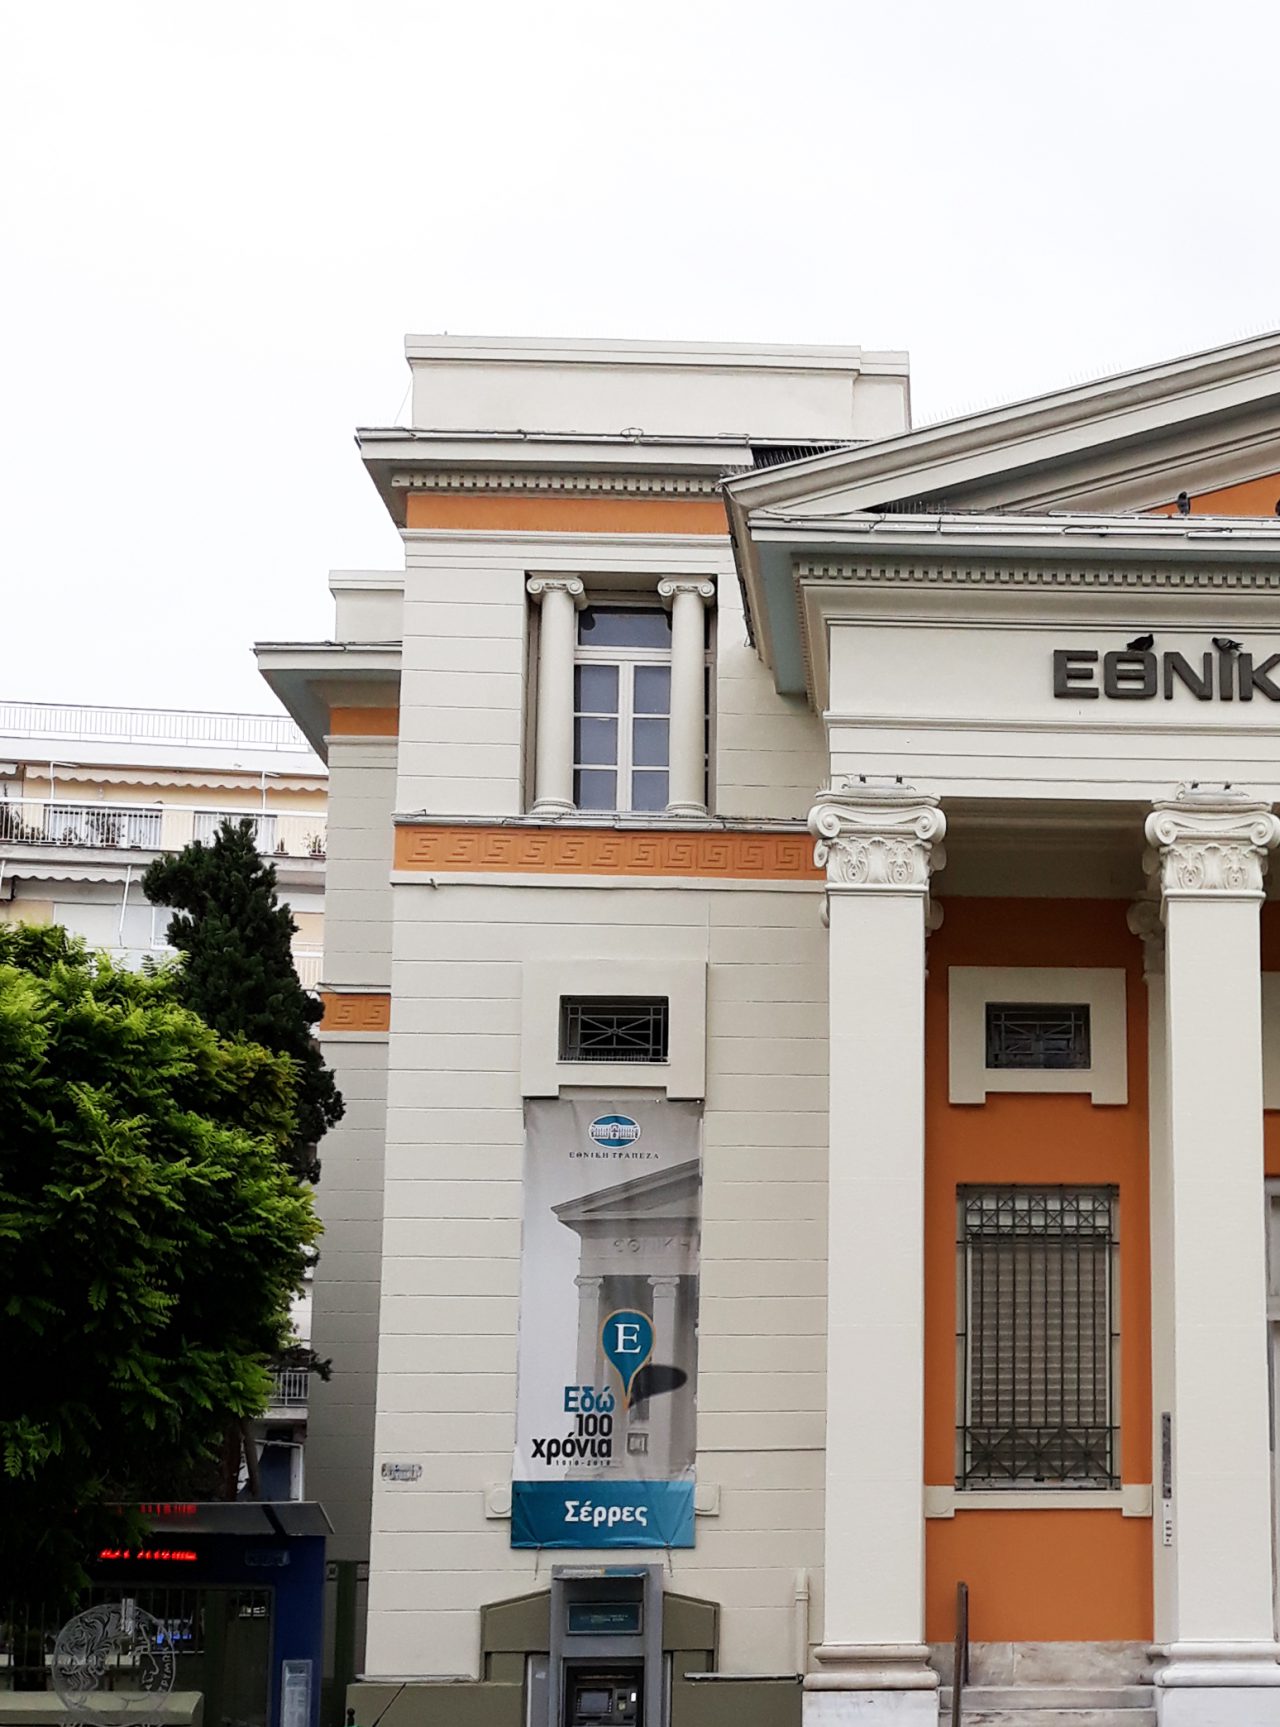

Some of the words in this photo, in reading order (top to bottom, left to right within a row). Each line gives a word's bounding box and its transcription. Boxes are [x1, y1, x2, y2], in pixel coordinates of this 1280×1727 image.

[564, 1386, 615, 1413] Εδώ
[576, 1413, 613, 1437] 100
[531, 1432, 612, 1465] χρόνια
[564, 1500, 648, 1527] Σέρρες
